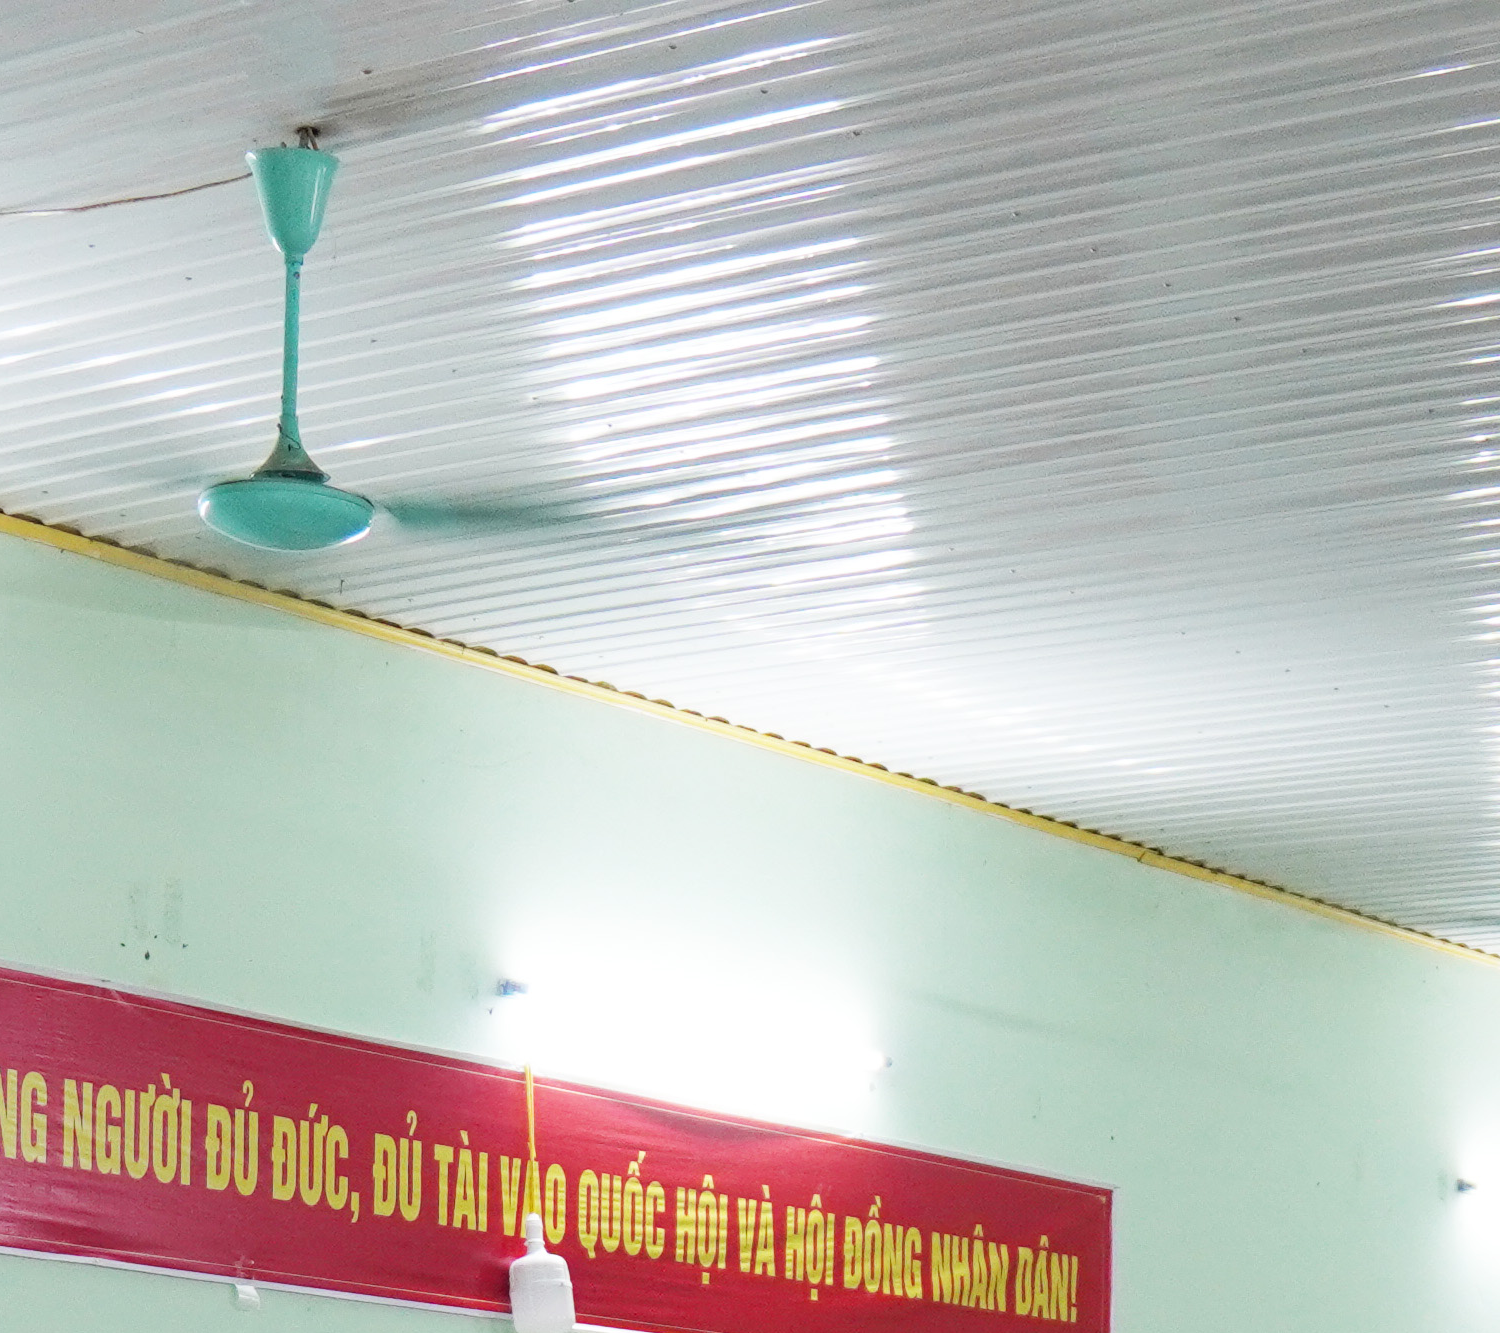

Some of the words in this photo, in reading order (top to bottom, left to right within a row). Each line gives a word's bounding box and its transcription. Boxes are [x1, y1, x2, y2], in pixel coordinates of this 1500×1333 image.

[62, 1072, 191, 1186] NGƯỜI
[205, 1080, 259, 1196] ĐỦ
[271, 1103, 361, 1223] ĐỨC,
[373, 1110, 422, 1222] ĐỦ
[434, 1130, 489, 1232] TÀI
[578, 1150, 666, 1259] QUỐC
[675, 1174, 728, 1285] HỘI
[737, 1184, 776, 1277] VÀ
[785, 1194, 835, 1301] HỘI
[843, 1195, 923, 1299] ĐỒNG
[931, 1223, 1009, 1312] NHÂN
[1015, 1234, 1079, 1323] DÂN!
